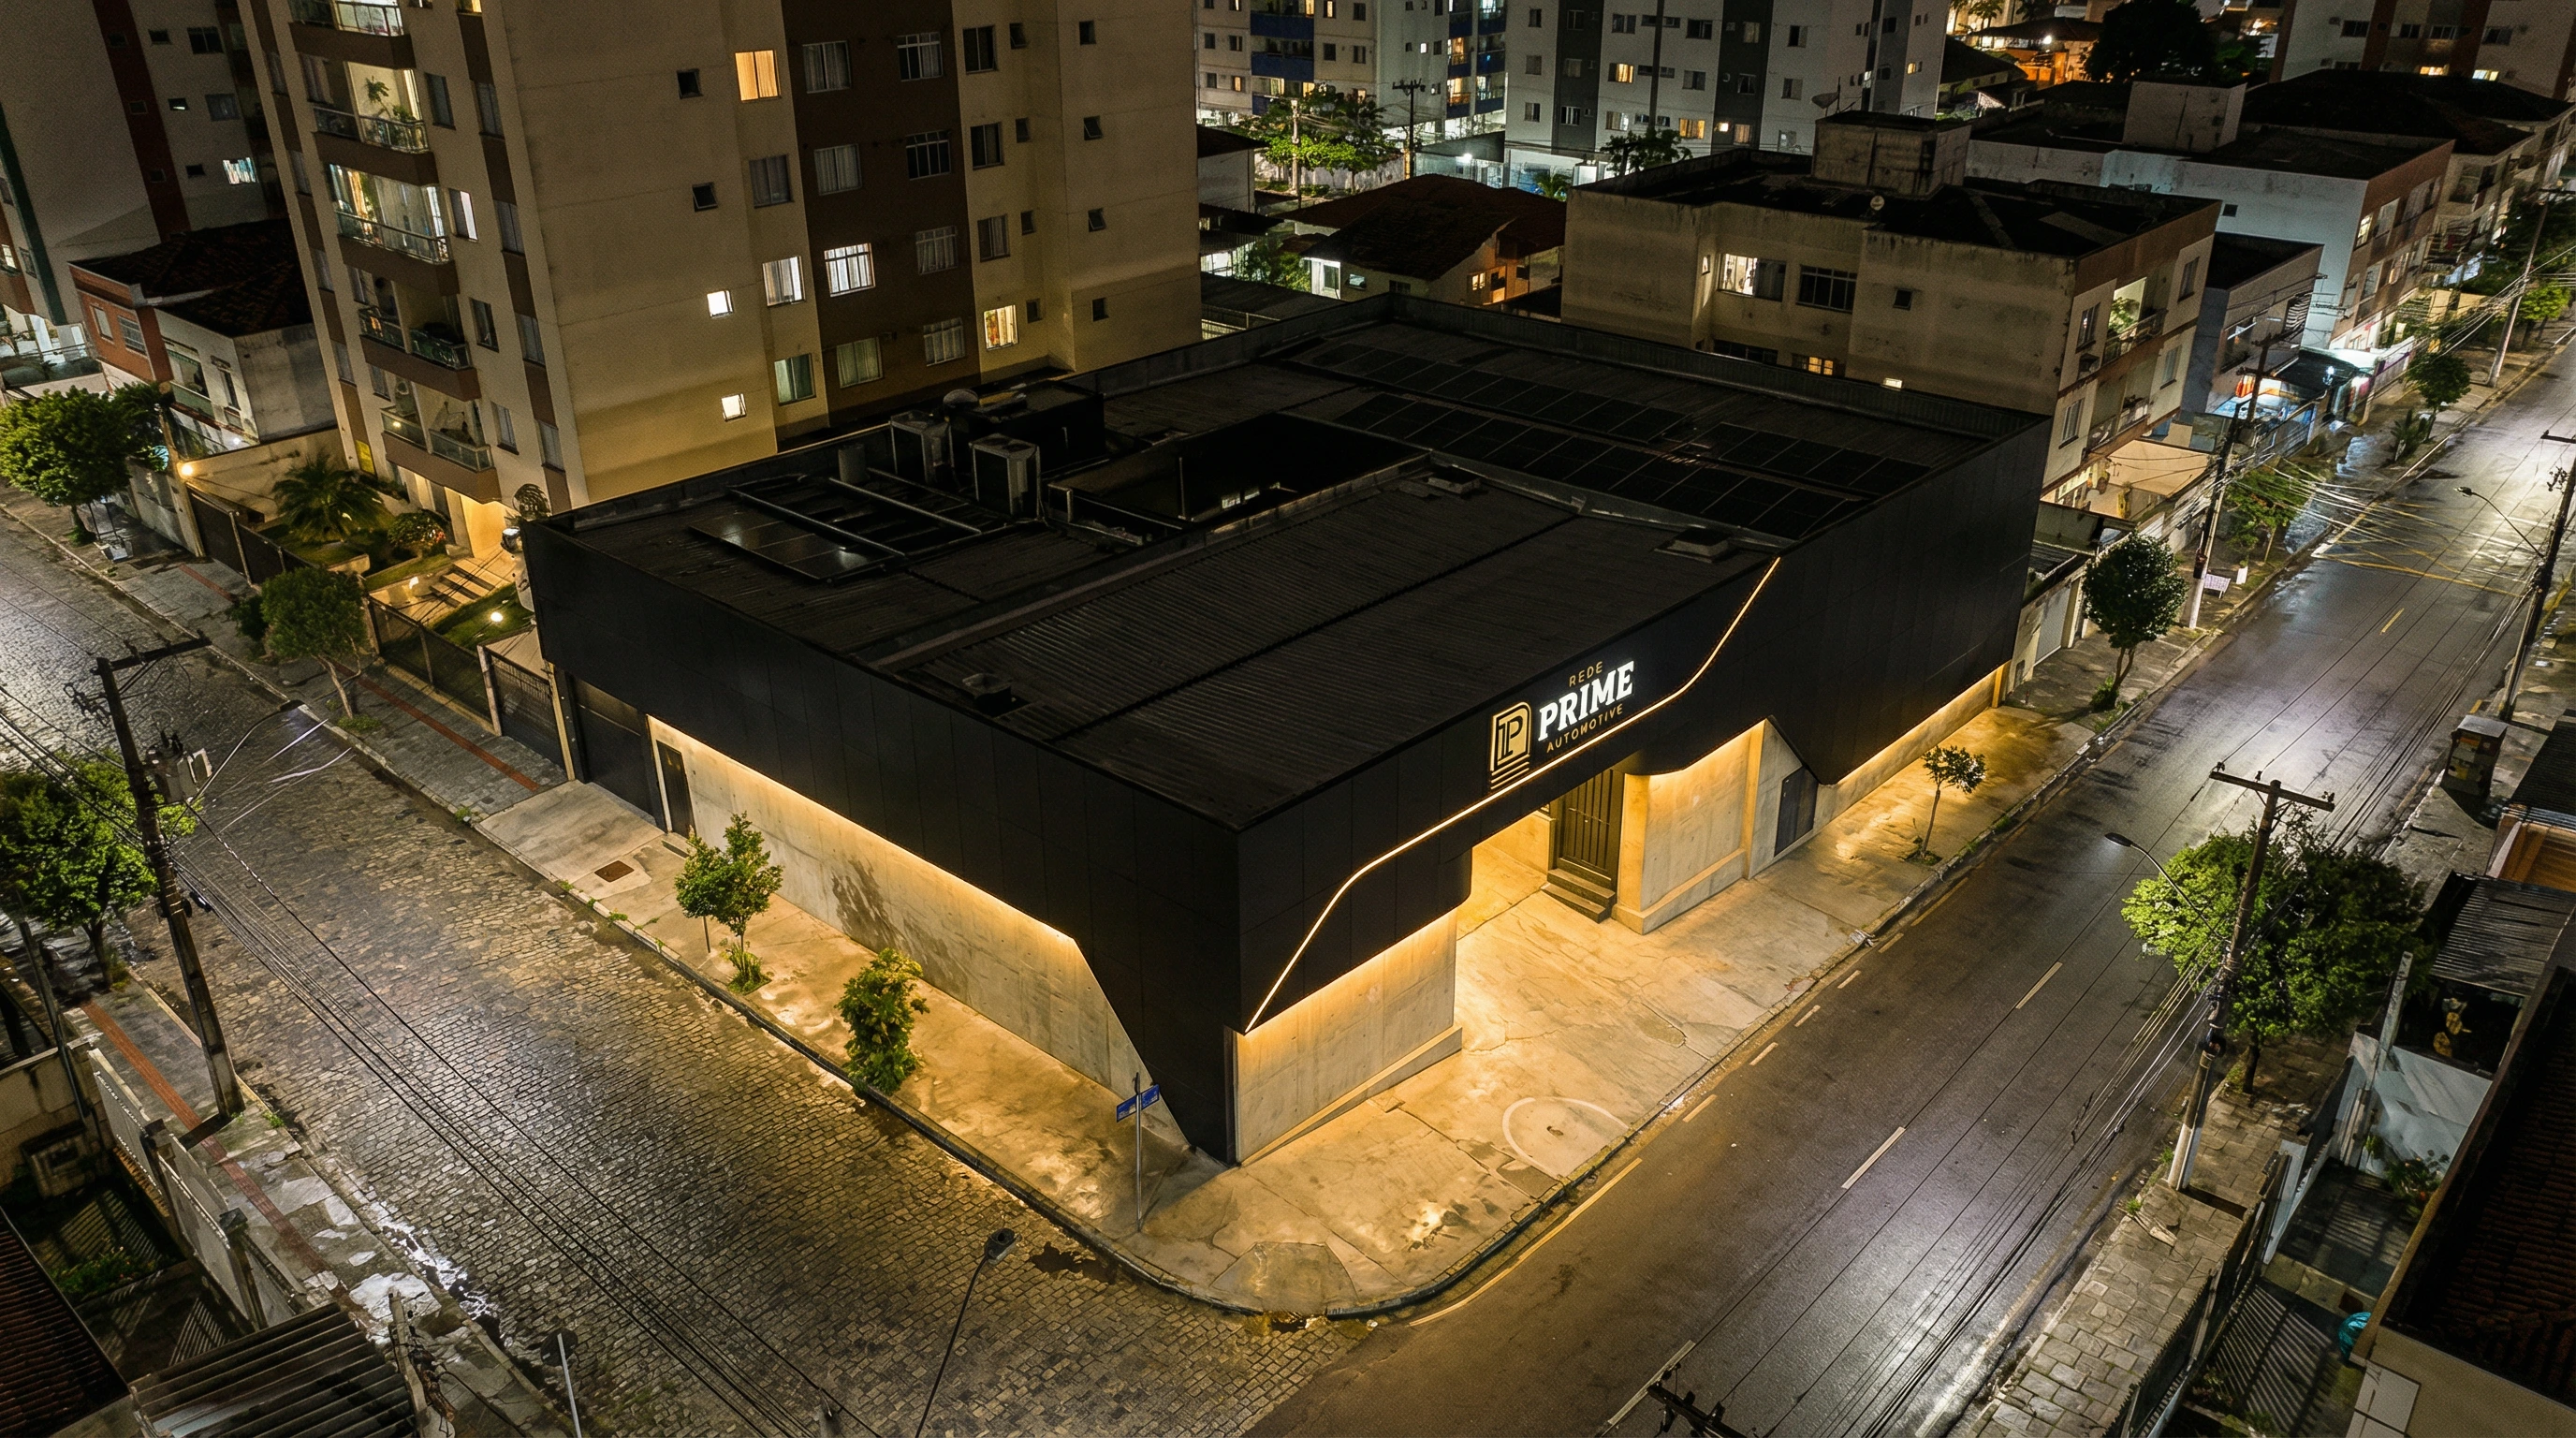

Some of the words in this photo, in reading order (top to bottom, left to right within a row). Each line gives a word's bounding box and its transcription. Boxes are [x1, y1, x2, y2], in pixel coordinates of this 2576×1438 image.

[1569, 661, 1603, 687] REDE
[1538, 660, 1634, 741] PRIME
[1546, 703, 1623, 753] AUTOMOTIVE
